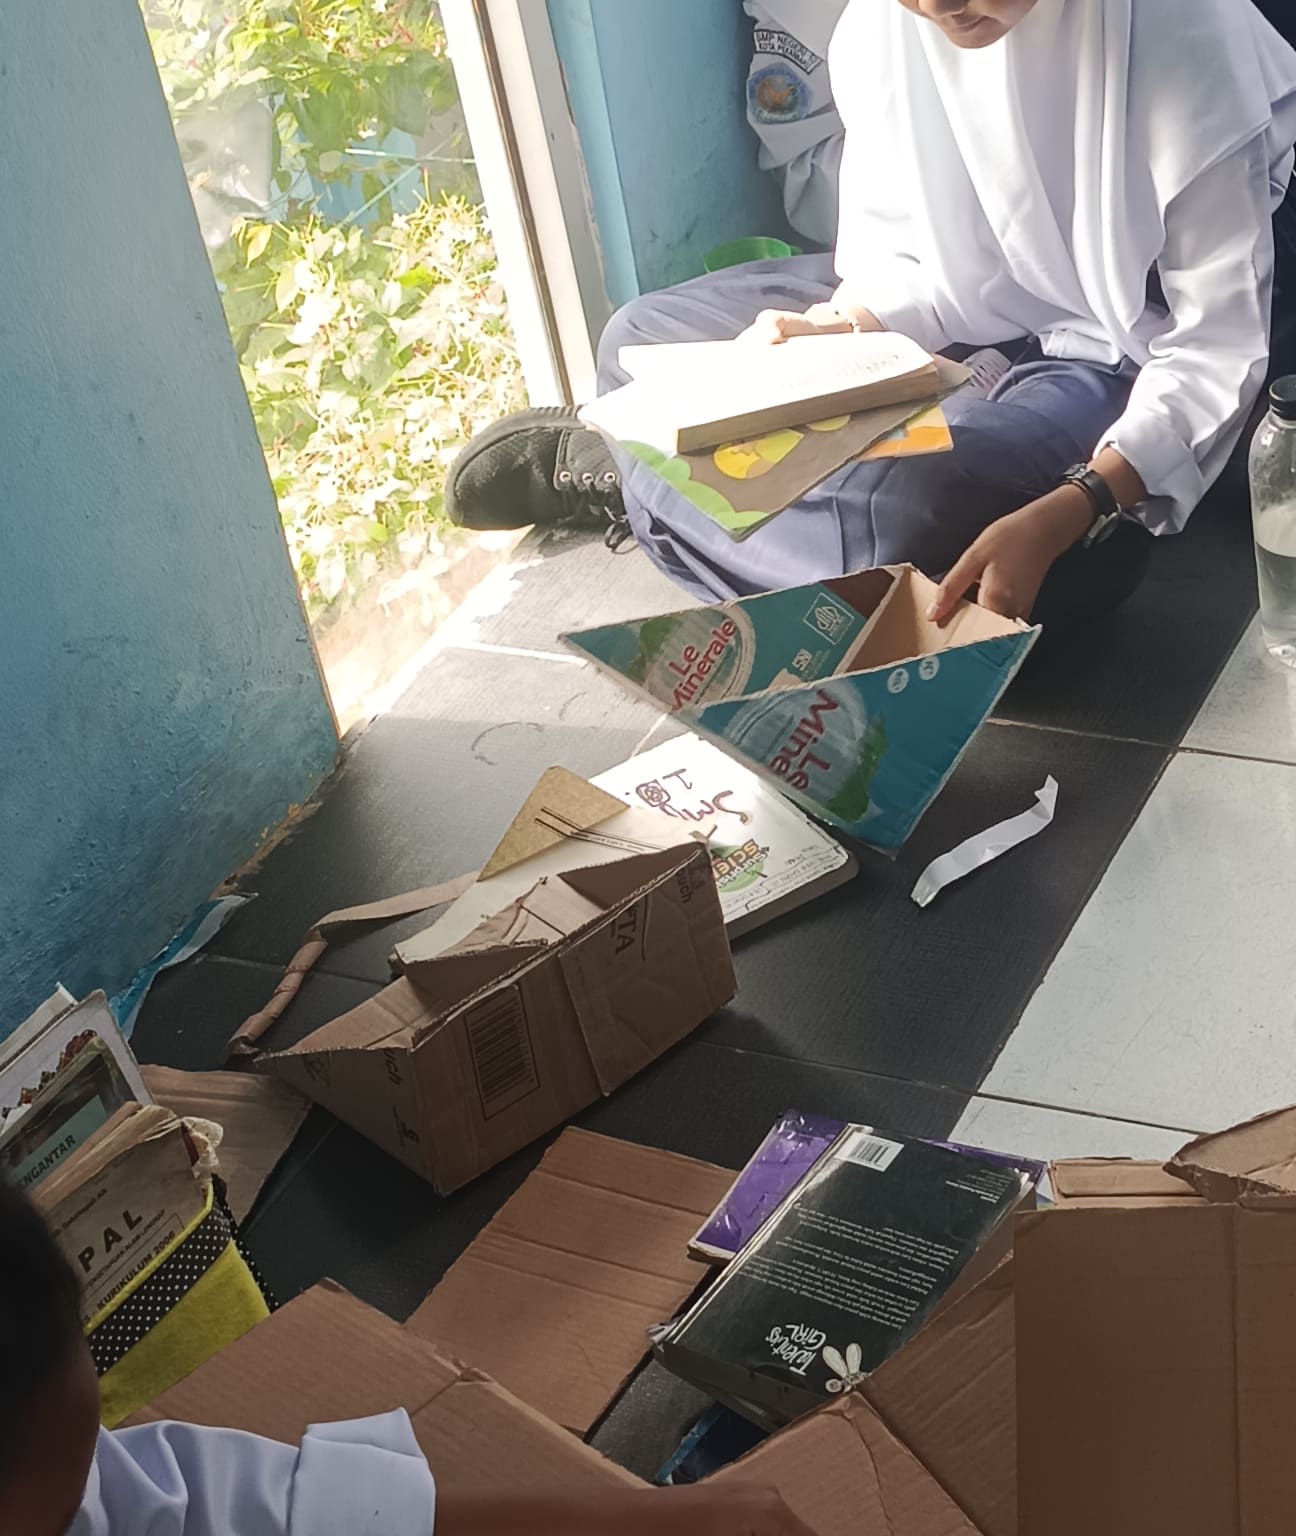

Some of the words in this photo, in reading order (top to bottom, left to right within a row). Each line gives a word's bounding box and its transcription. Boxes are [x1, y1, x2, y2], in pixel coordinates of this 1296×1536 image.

[668, 644, 700, 677] Le
[786, 751, 832, 790] Le
[97, 1255, 154, 1310] KURIKULUM
[153, 1230, 177, 1257] 2006
